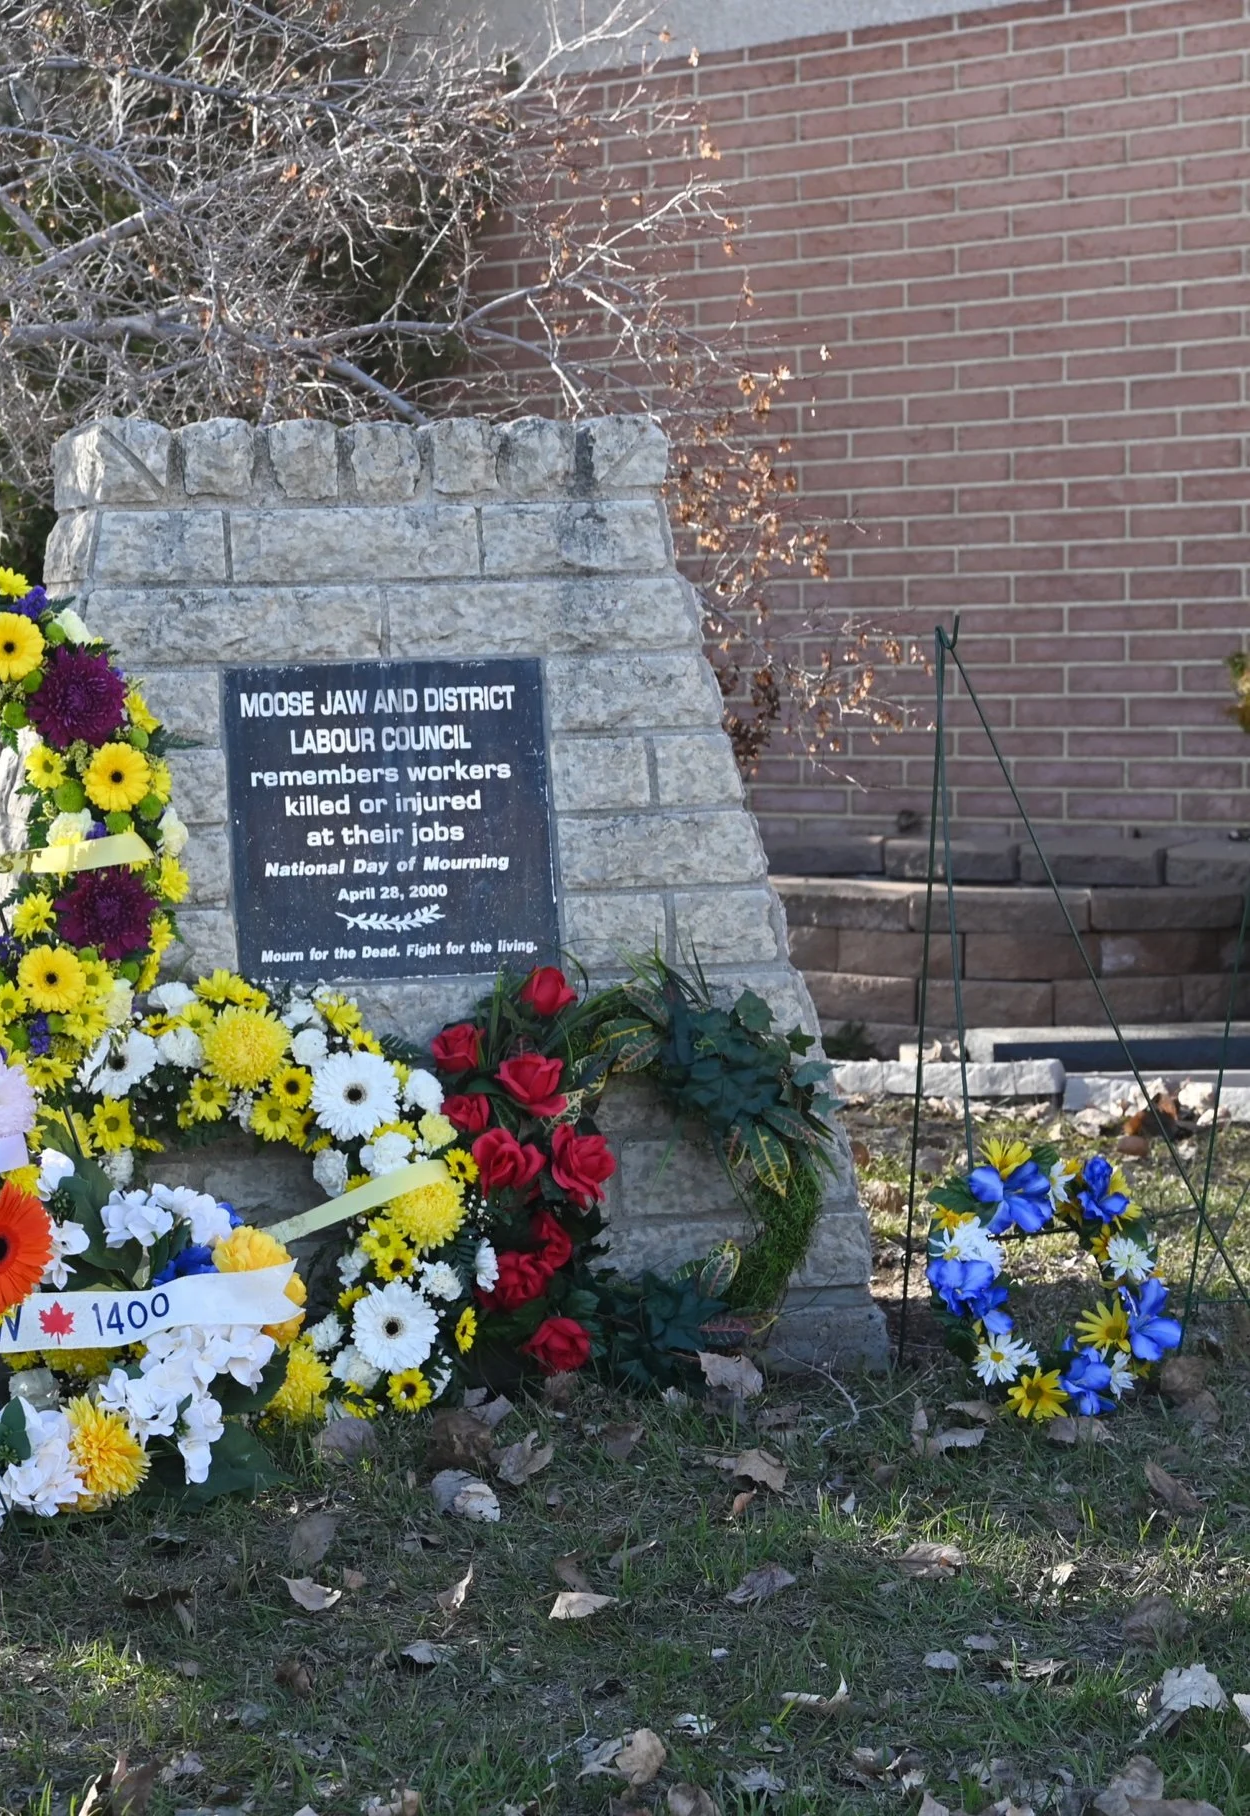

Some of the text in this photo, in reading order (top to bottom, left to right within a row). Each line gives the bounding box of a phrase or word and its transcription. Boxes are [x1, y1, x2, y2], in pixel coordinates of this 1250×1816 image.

[240, 685, 515, 718] MOOSE JAW AND DISTRICT
[290, 725, 471, 754] LABOUR COUNCIL
[251, 760, 511, 787] remembers workers
[285, 790, 481, 816] killed or injured
[306, 822, 464, 847] at their jobs
[265, 854, 509, 877] National Day of Mourning
[337, 885, 447, 902] April 28, 2000
[261, 939, 538, 963] Mourn for the Dead. Fight for the living.
[91, 1292, 170, 1336] 1400
